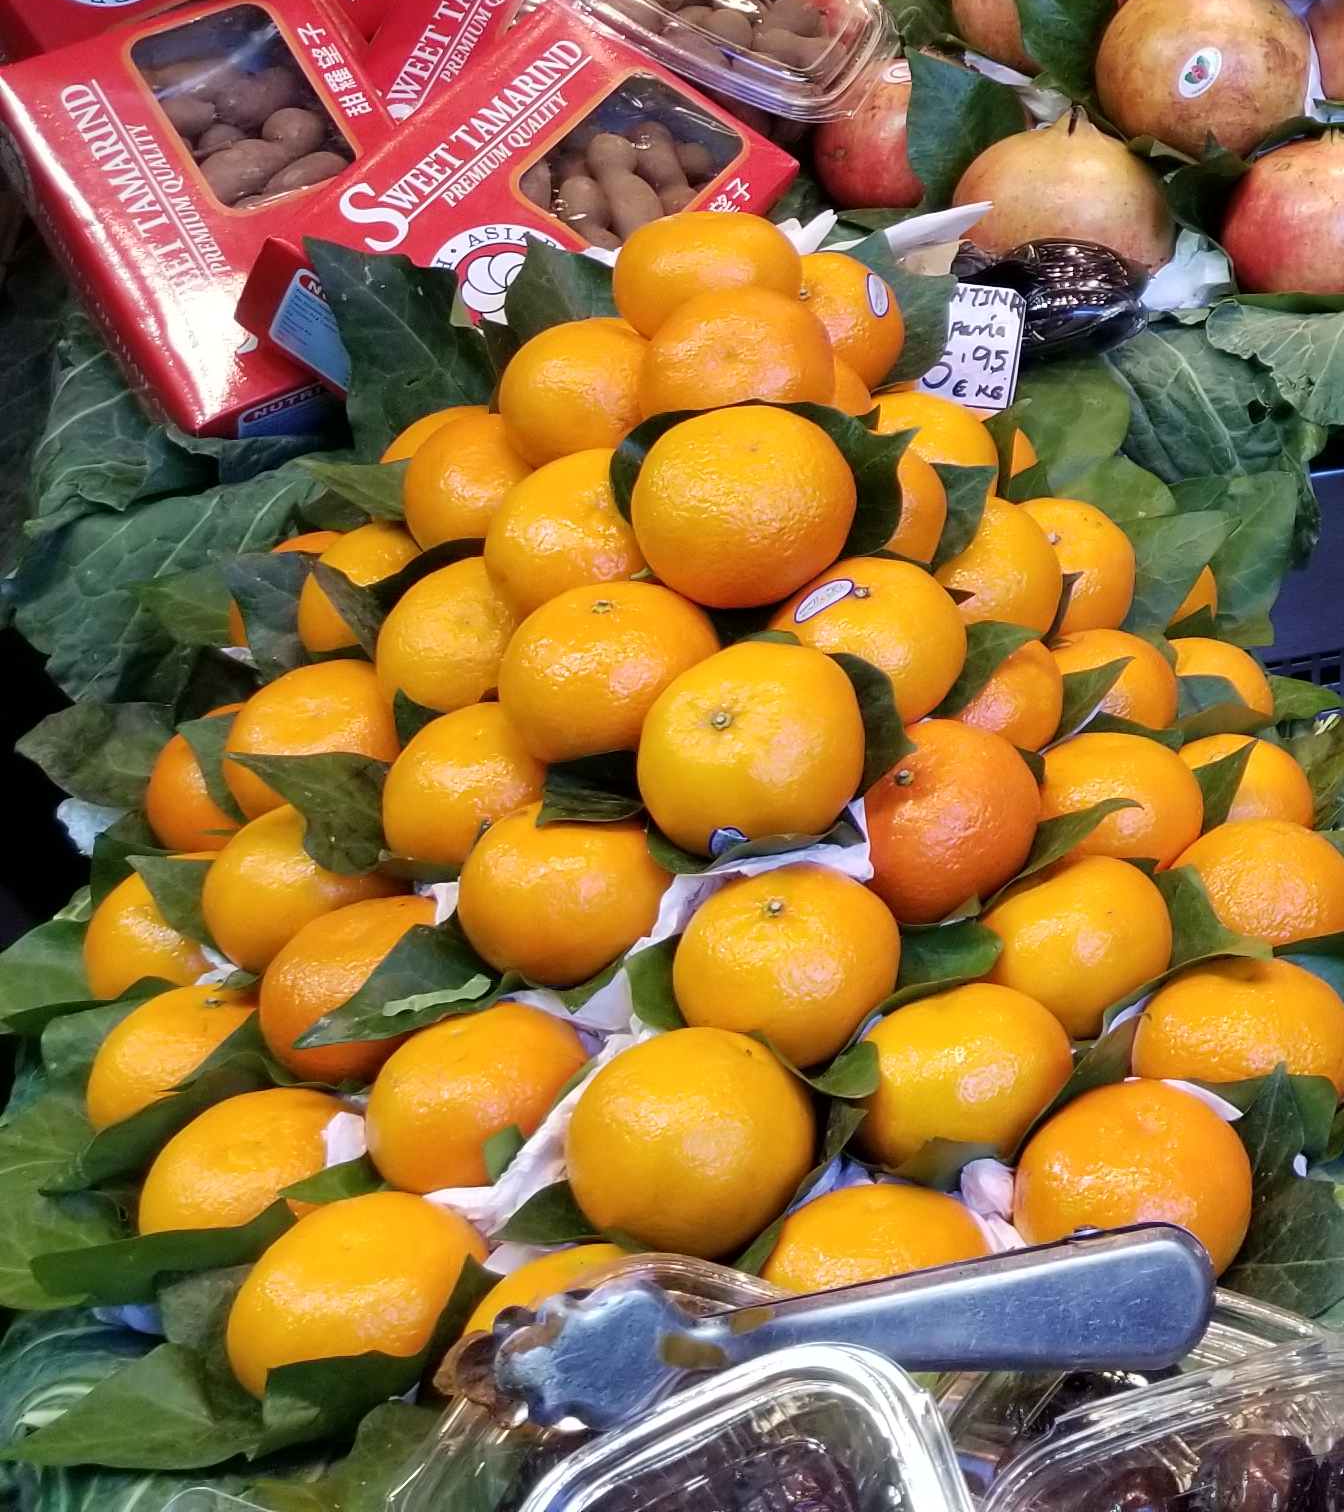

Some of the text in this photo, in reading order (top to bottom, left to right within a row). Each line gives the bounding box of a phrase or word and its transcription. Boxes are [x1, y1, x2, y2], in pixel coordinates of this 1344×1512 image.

[440, 7, 487, 84] PREMIUM
[60, 84, 170, 238] TAMARIND
[125, 124, 231, 277] PREMIUM QUALITY
[339, 40, 583, 253] SWEET TAMARIND
[443, 89, 571, 209] PREMIUM QUALITY
